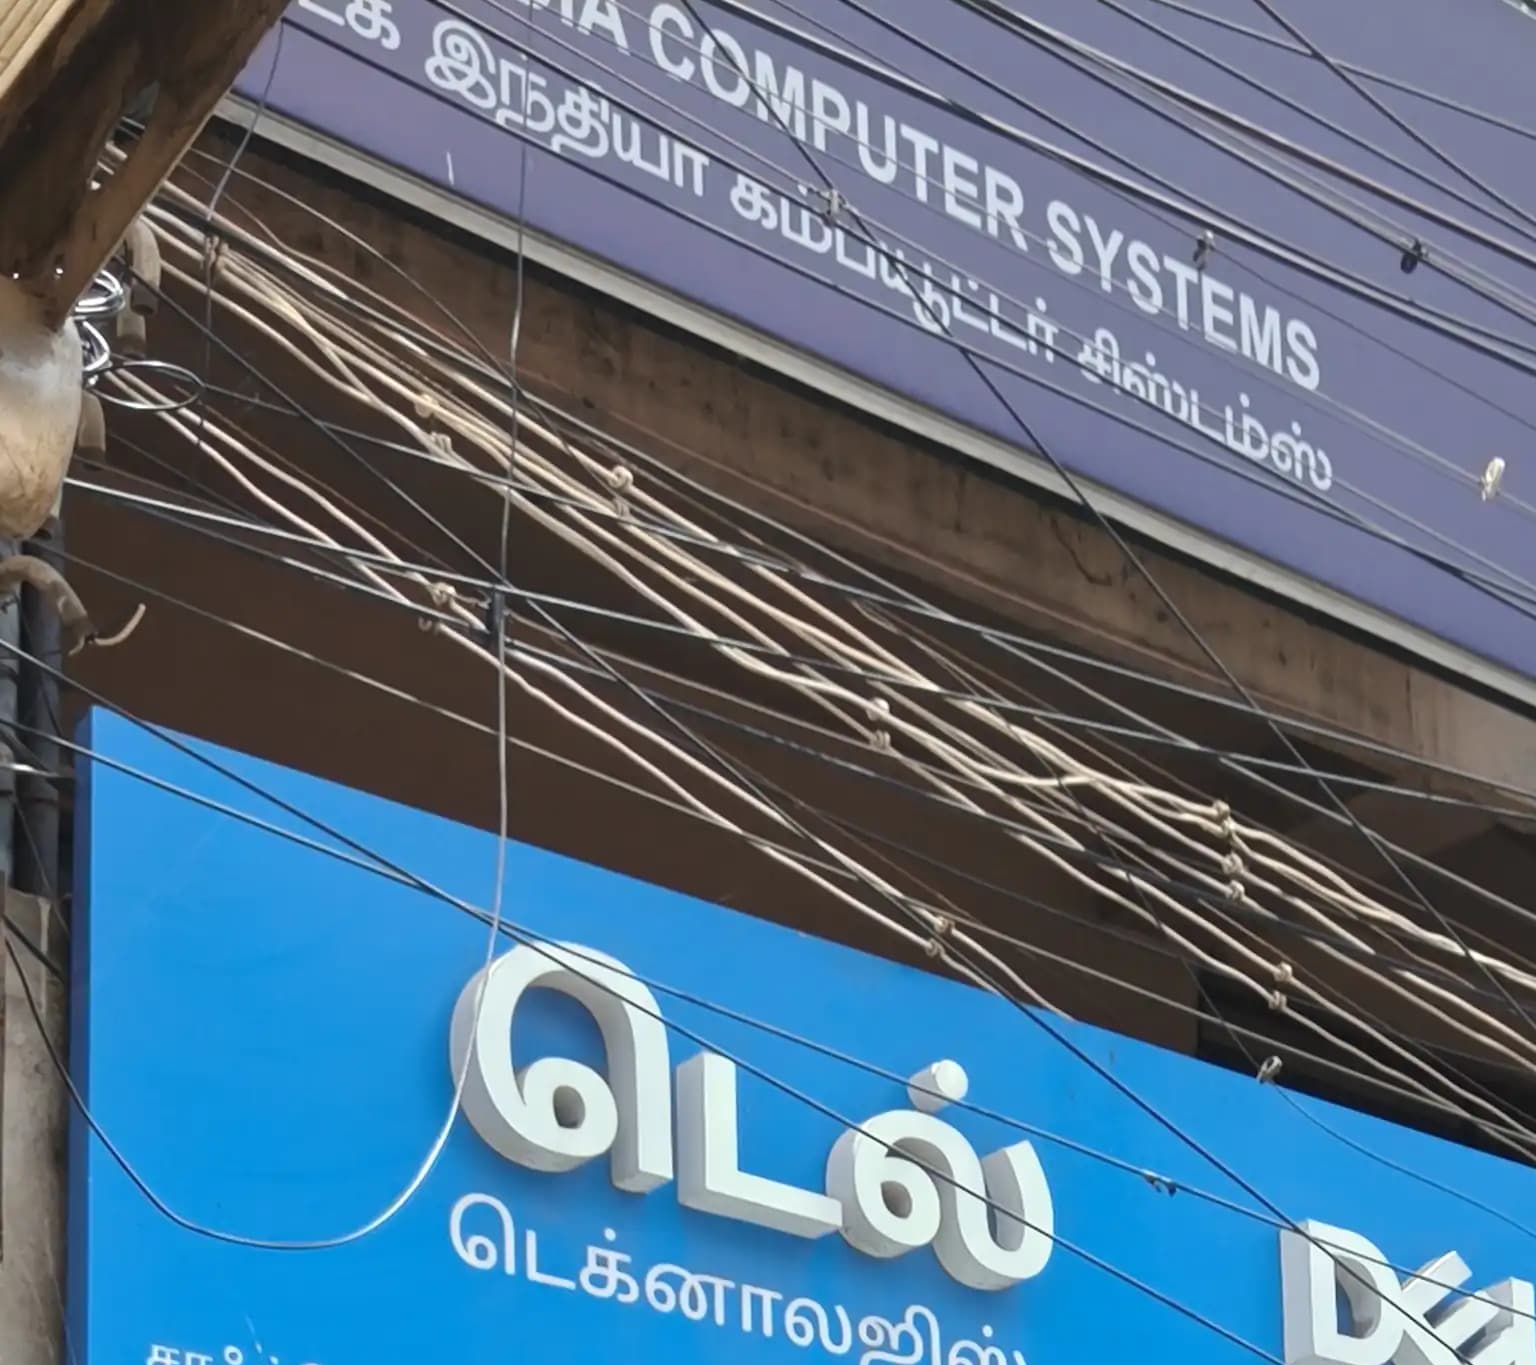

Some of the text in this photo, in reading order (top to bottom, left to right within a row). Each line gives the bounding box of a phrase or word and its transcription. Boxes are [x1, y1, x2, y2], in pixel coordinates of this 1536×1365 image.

[648, 3, 1322, 391] COMPUTER SYSTEMS
[448, 940, 1054, 1293] டெல்
